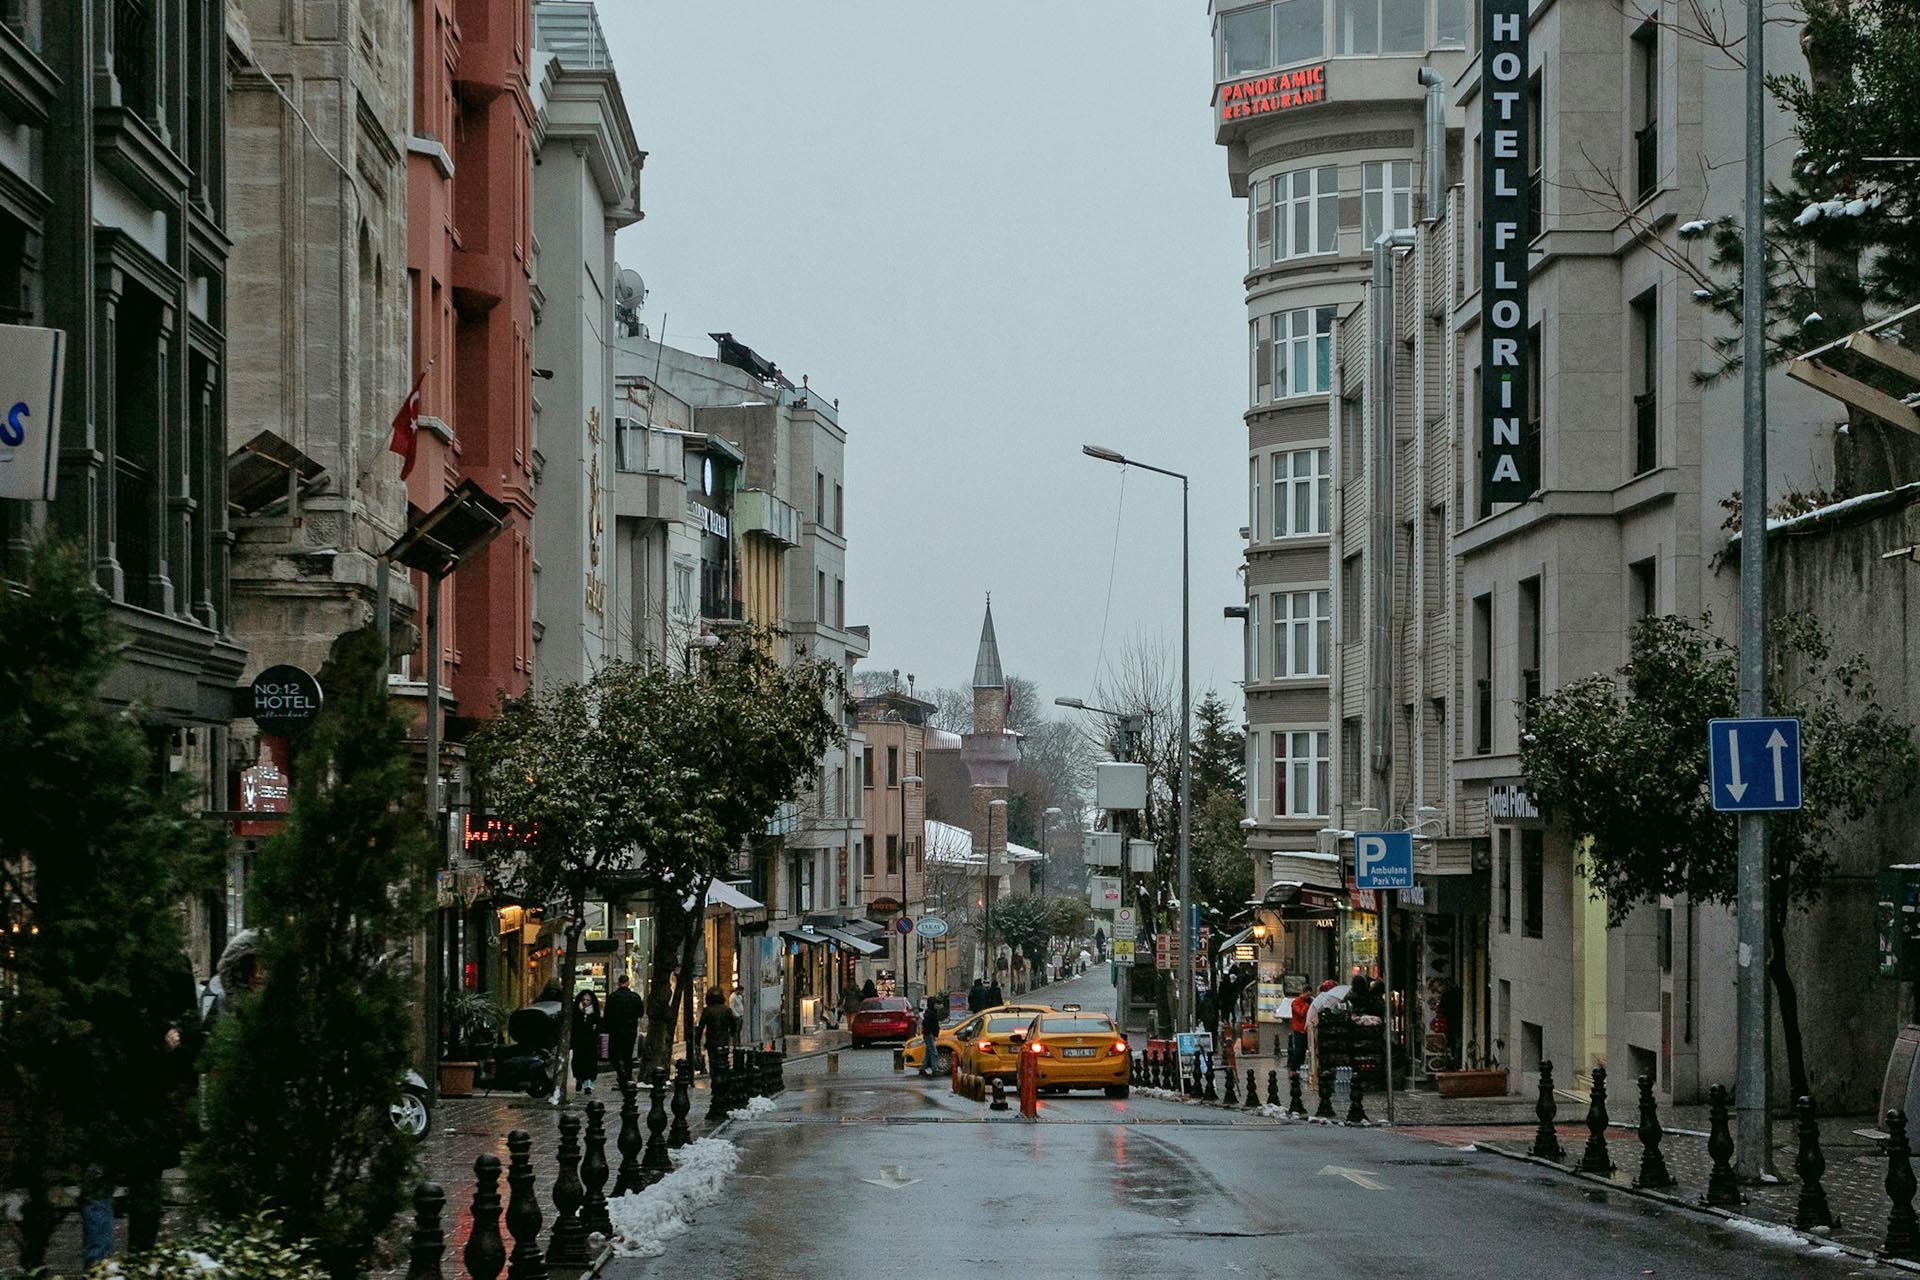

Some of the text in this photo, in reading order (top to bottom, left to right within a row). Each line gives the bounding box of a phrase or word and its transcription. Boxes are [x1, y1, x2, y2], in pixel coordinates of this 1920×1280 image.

[1222, 65, 1324, 102] PANORAMIC
[1223, 86, 1324, 119] RESTAURANT
[1492, 13, 1521, 196] HOTEL
[255, 695, 316, 709] HOTEL
[1488, 785, 1509, 818] Hotel
[1359, 836, 1387, 877] P
[1370, 866, 1408, 874] Ambulans
[1372, 877, 1406, 885] Park Yeri
